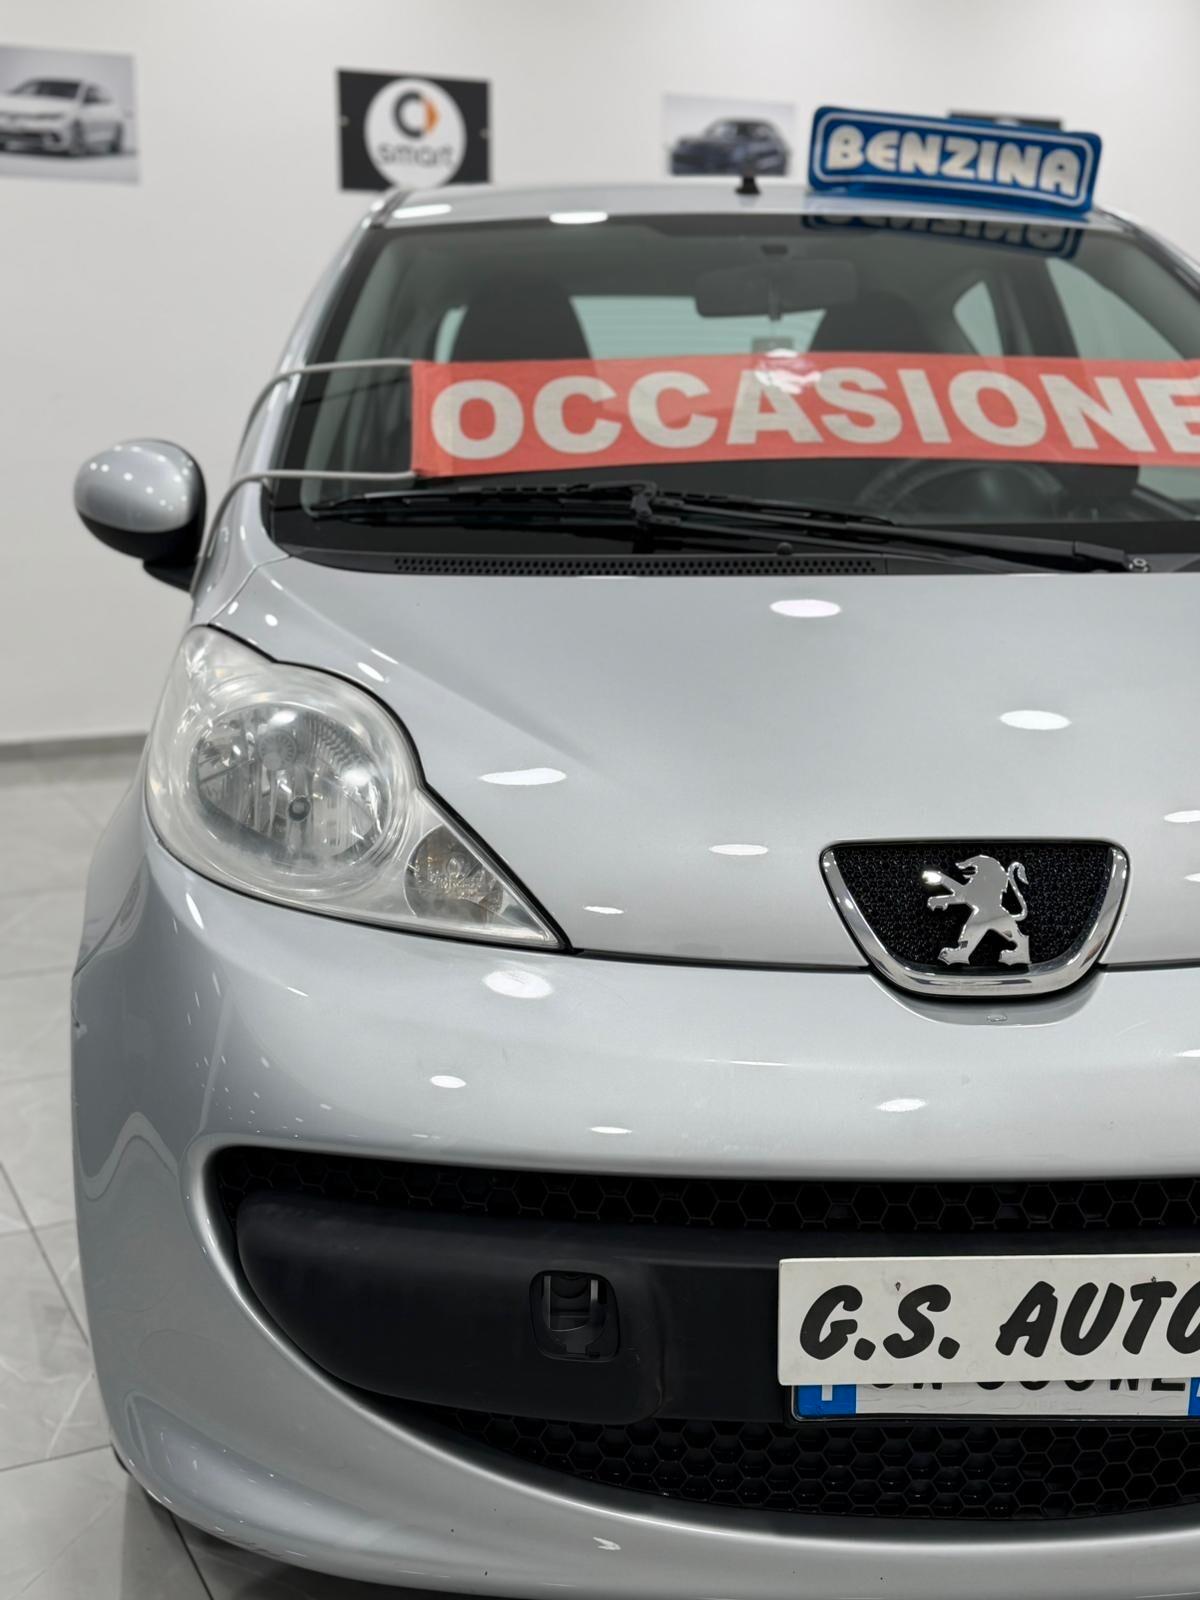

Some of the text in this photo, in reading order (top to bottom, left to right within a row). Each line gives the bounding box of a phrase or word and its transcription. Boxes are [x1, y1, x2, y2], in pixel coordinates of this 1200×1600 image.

[378, 142, 454, 168] smart
[825, 124, 1081, 198] BENZINA
[799, 1284, 961, 1361] G.S.
